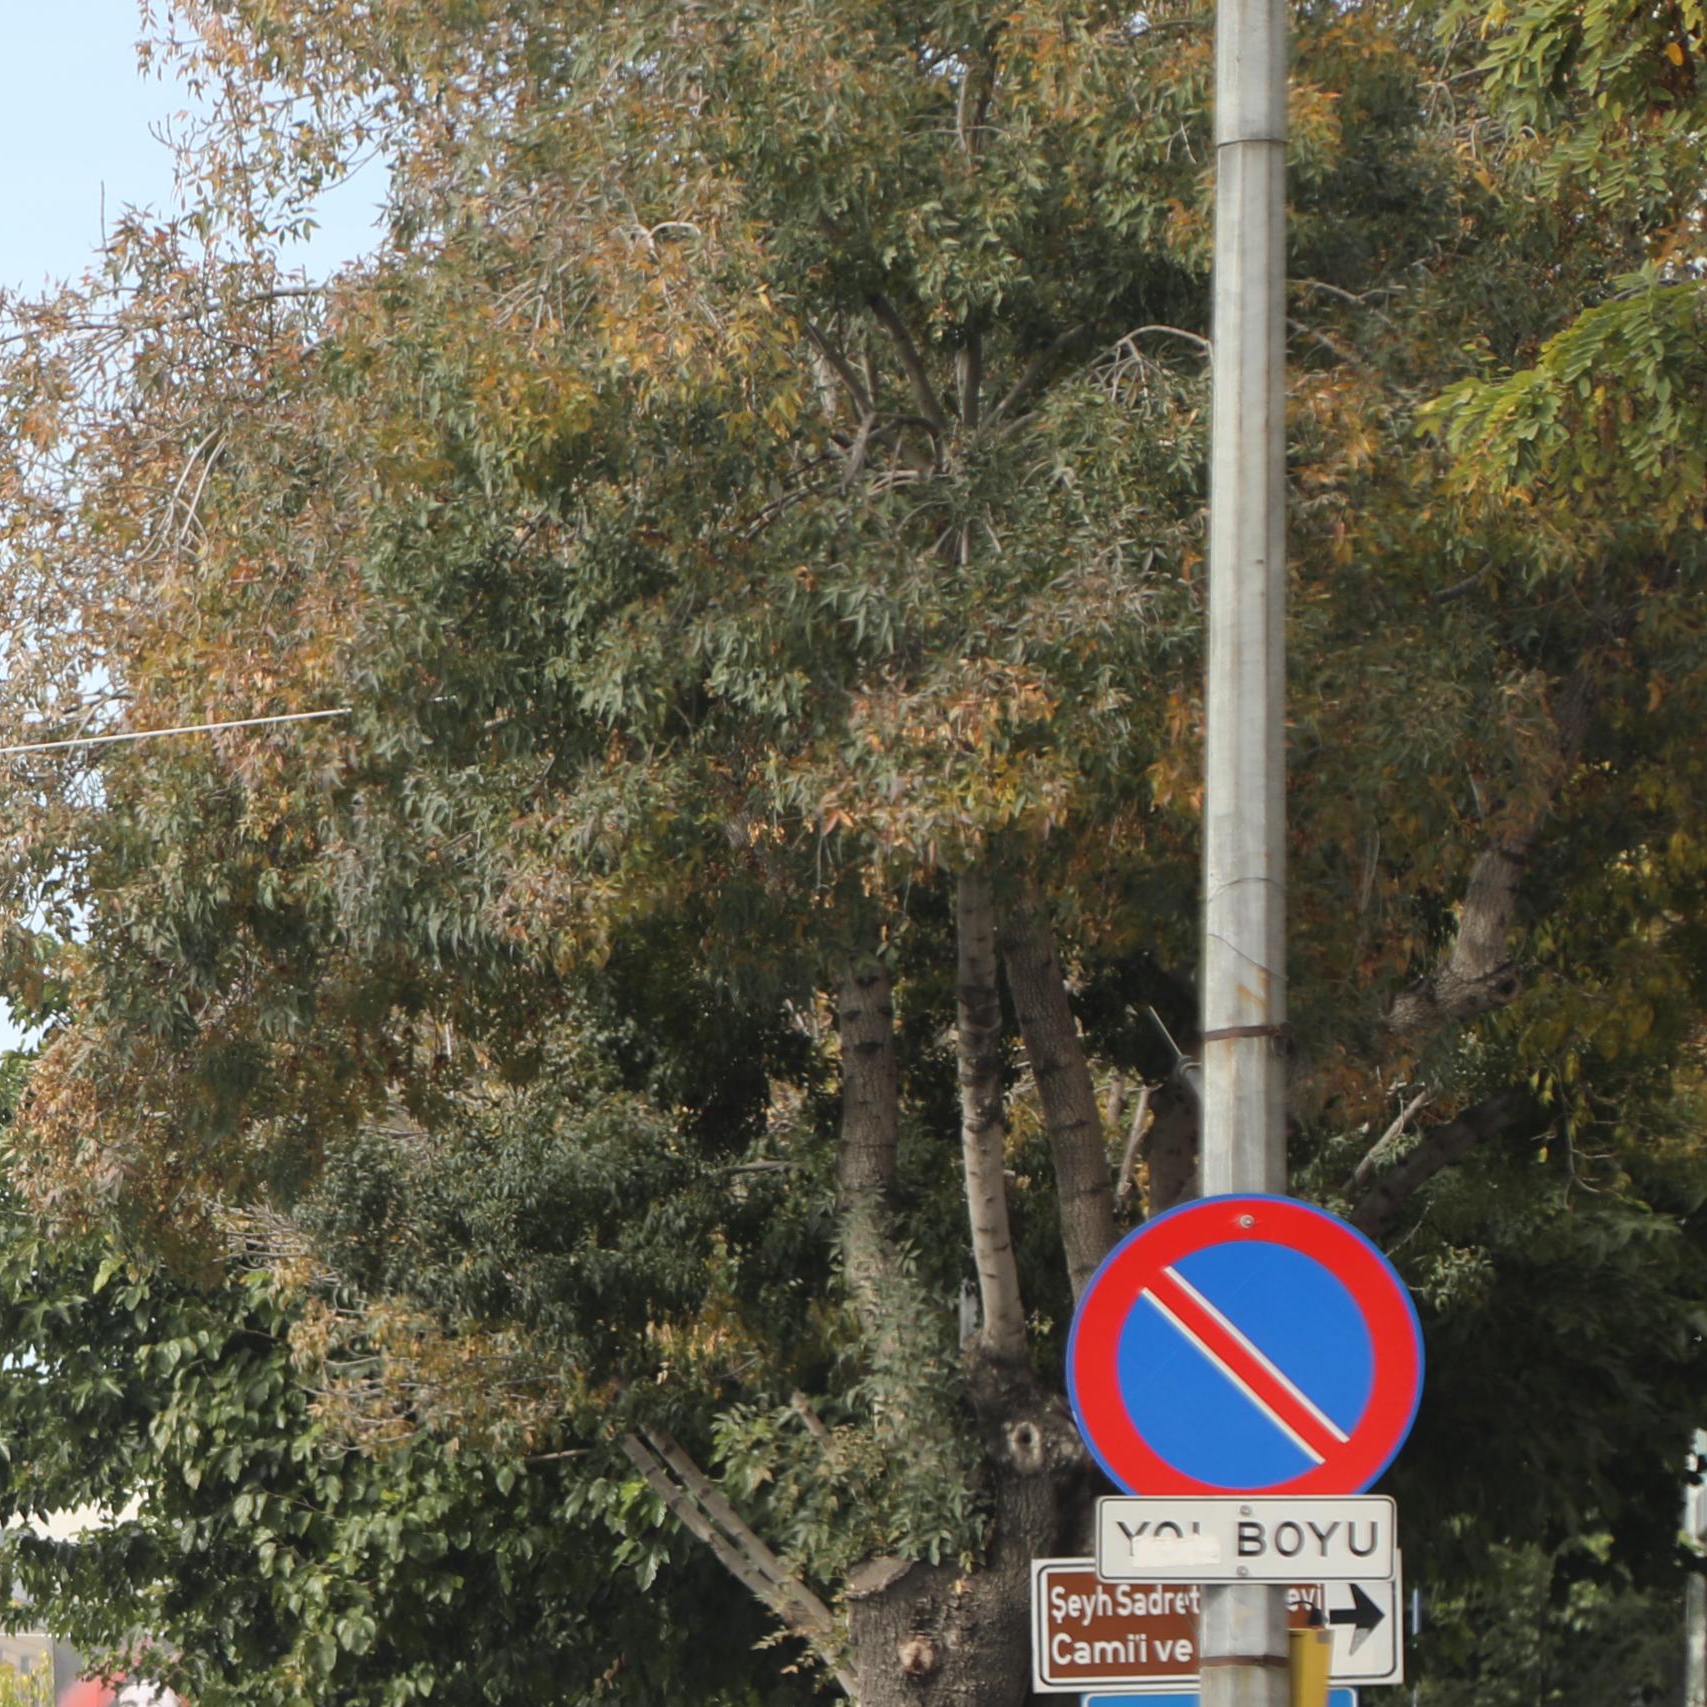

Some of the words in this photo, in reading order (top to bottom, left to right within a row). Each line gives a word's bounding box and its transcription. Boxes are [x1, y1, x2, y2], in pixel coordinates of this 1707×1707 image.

[1237, 1520, 1379, 1557] BOYU
[1051, 1584, 1113, 1626] Şeyh
[1115, 1583, 1201, 1616] Sadret
[1285, 1583, 1322, 1612] evi
[1153, 1638, 1194, 1663] ve
